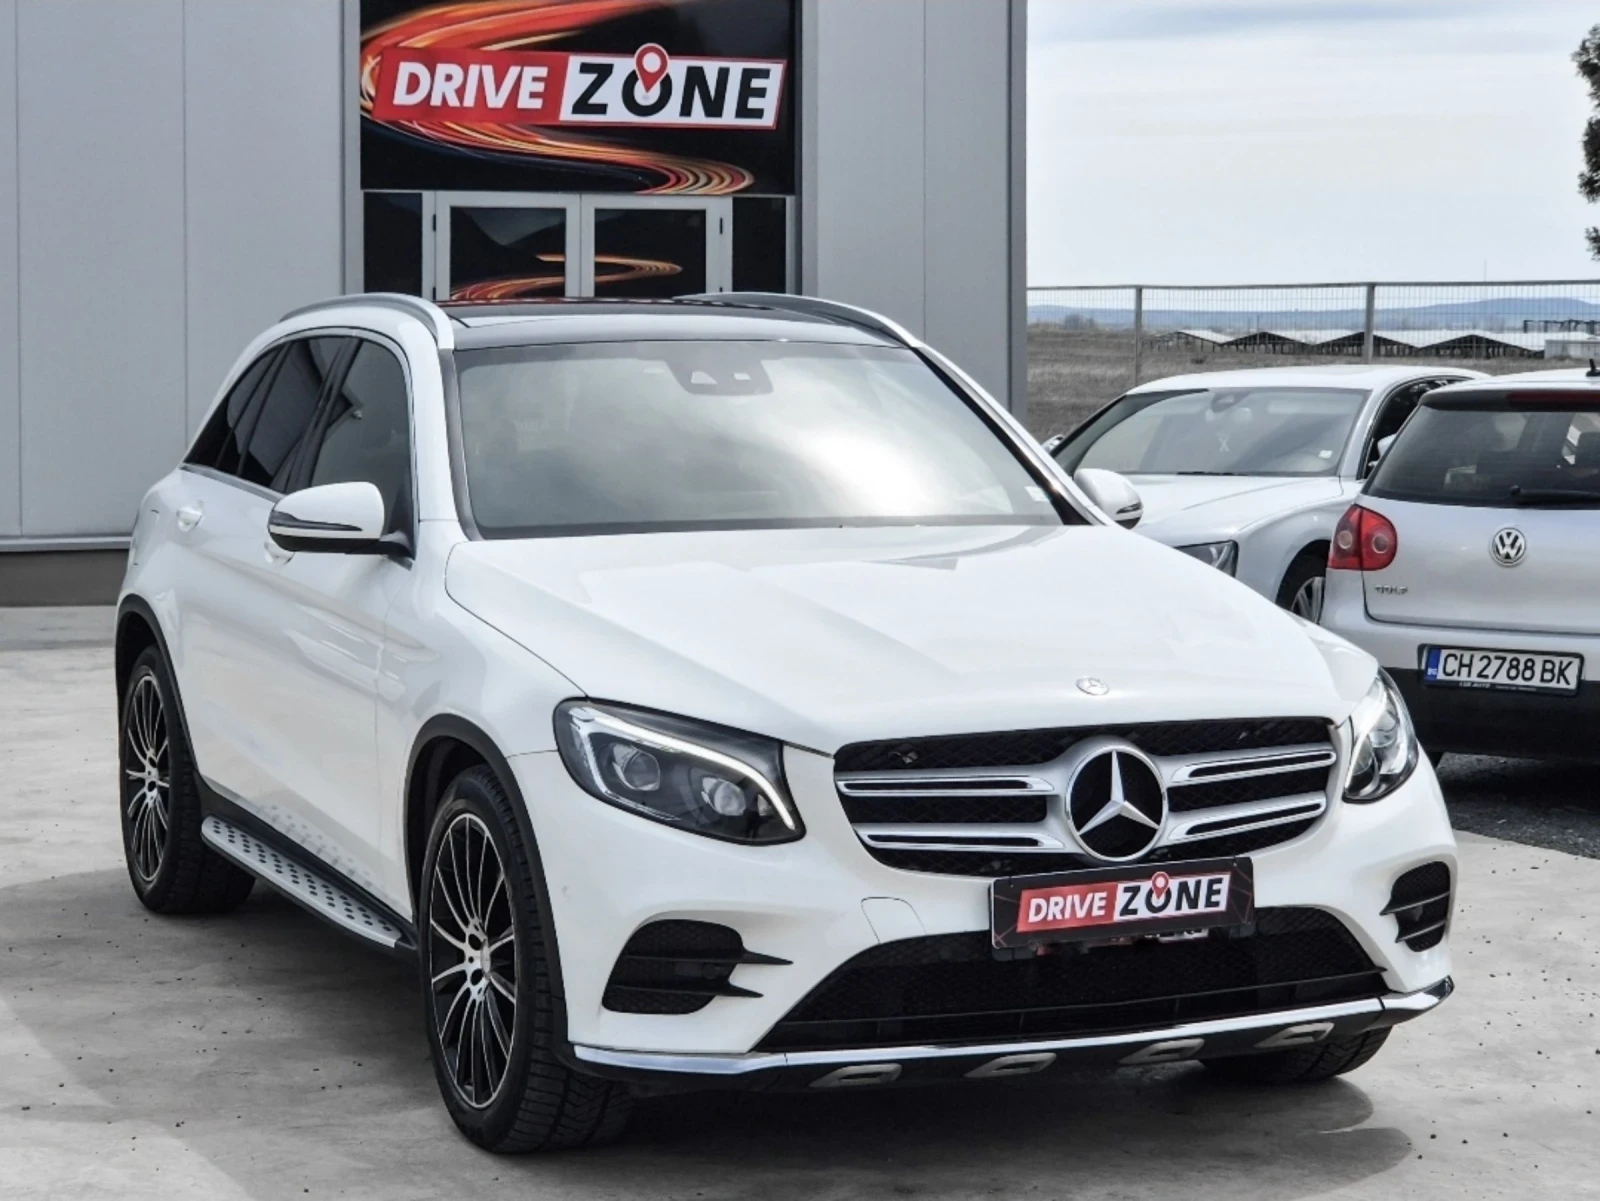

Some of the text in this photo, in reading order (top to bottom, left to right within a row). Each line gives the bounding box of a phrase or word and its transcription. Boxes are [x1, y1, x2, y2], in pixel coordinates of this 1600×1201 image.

[392, 61, 771, 120] DRIVE ZONE
[1027, 876, 1224, 924] DRIVE ZONE
